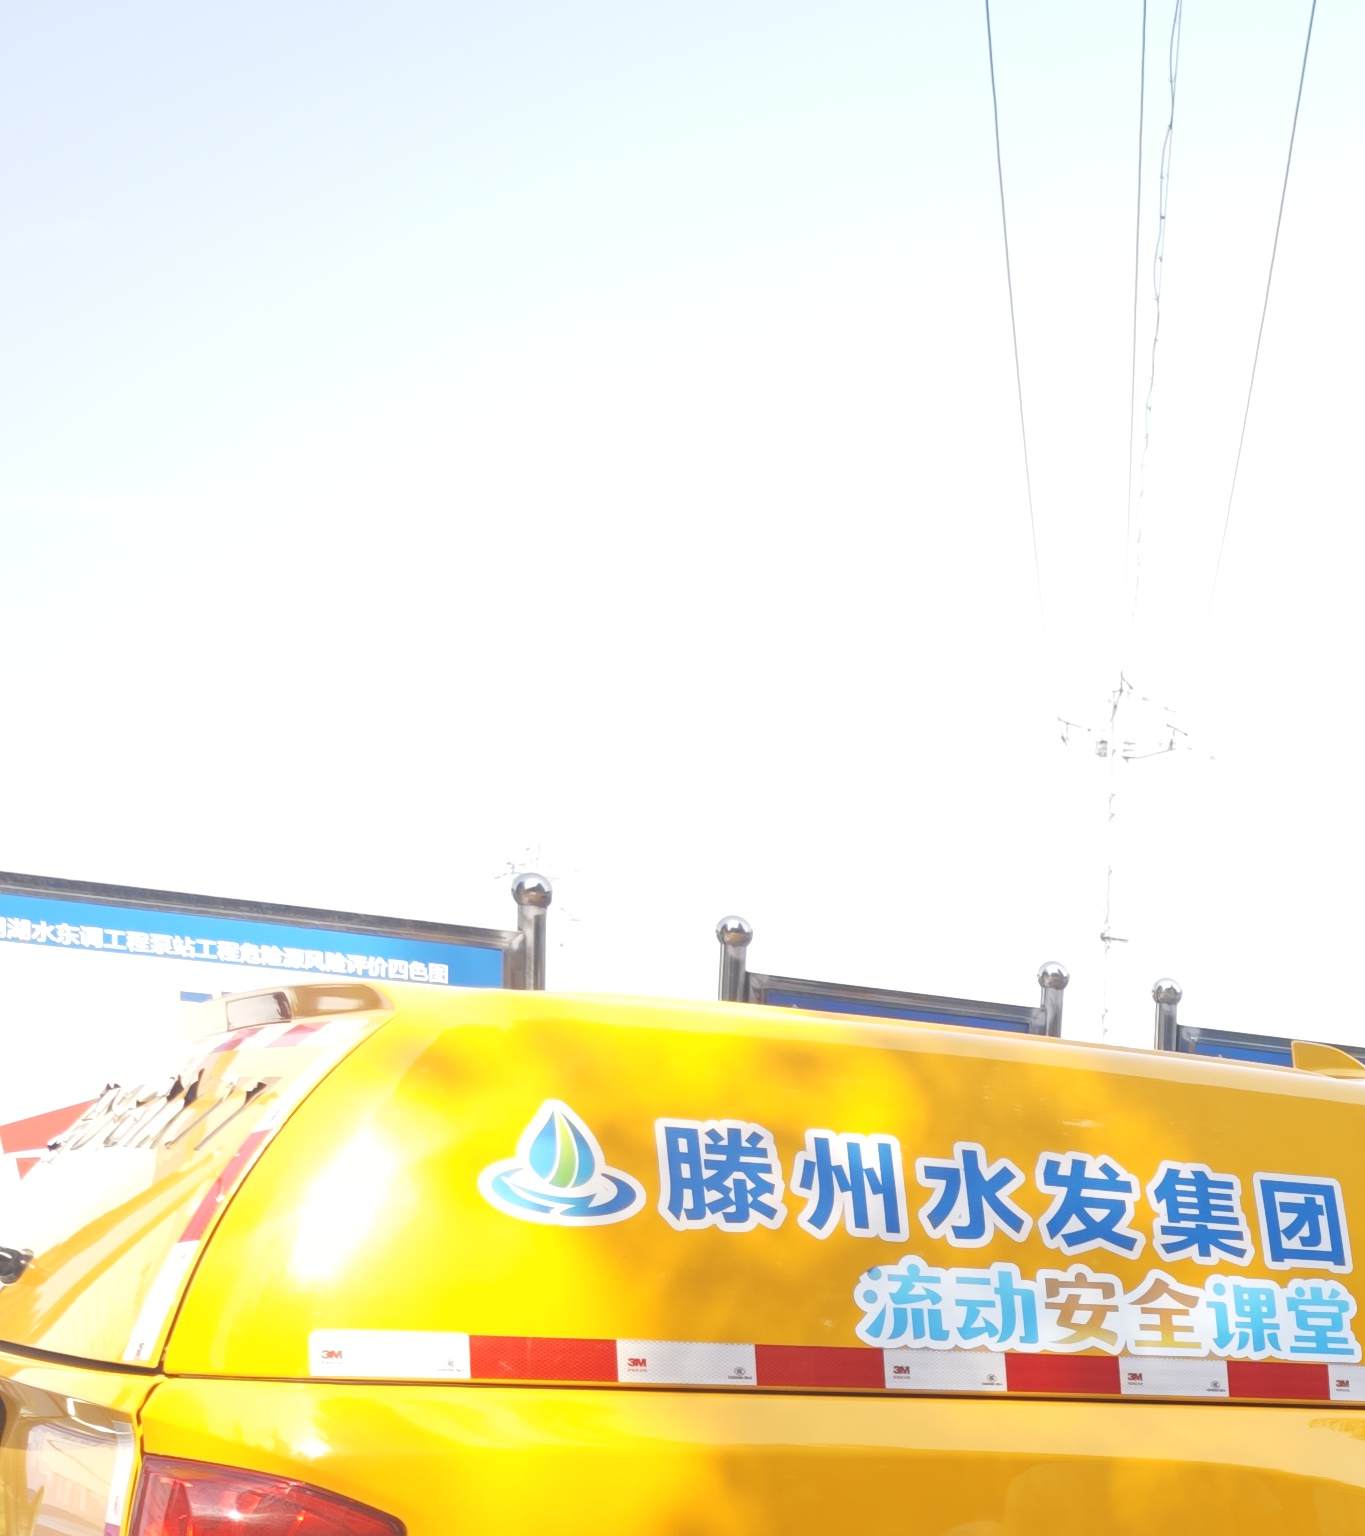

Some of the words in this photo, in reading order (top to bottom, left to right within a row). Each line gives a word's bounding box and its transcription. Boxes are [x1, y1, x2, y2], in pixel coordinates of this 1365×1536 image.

[664, 1126, 1347, 1270] 滕州水发集团
[864, 1266, 1355, 1357] 流动安全课堂
[321, 1350, 342, 1359] 3M
[627, 1358, 647, 1367] 3M
[893, 1366, 911, 1375] 3M
[1127, 1372, 1143, 1381] 3M
[1336, 1380, 1350, 1388] 3M
